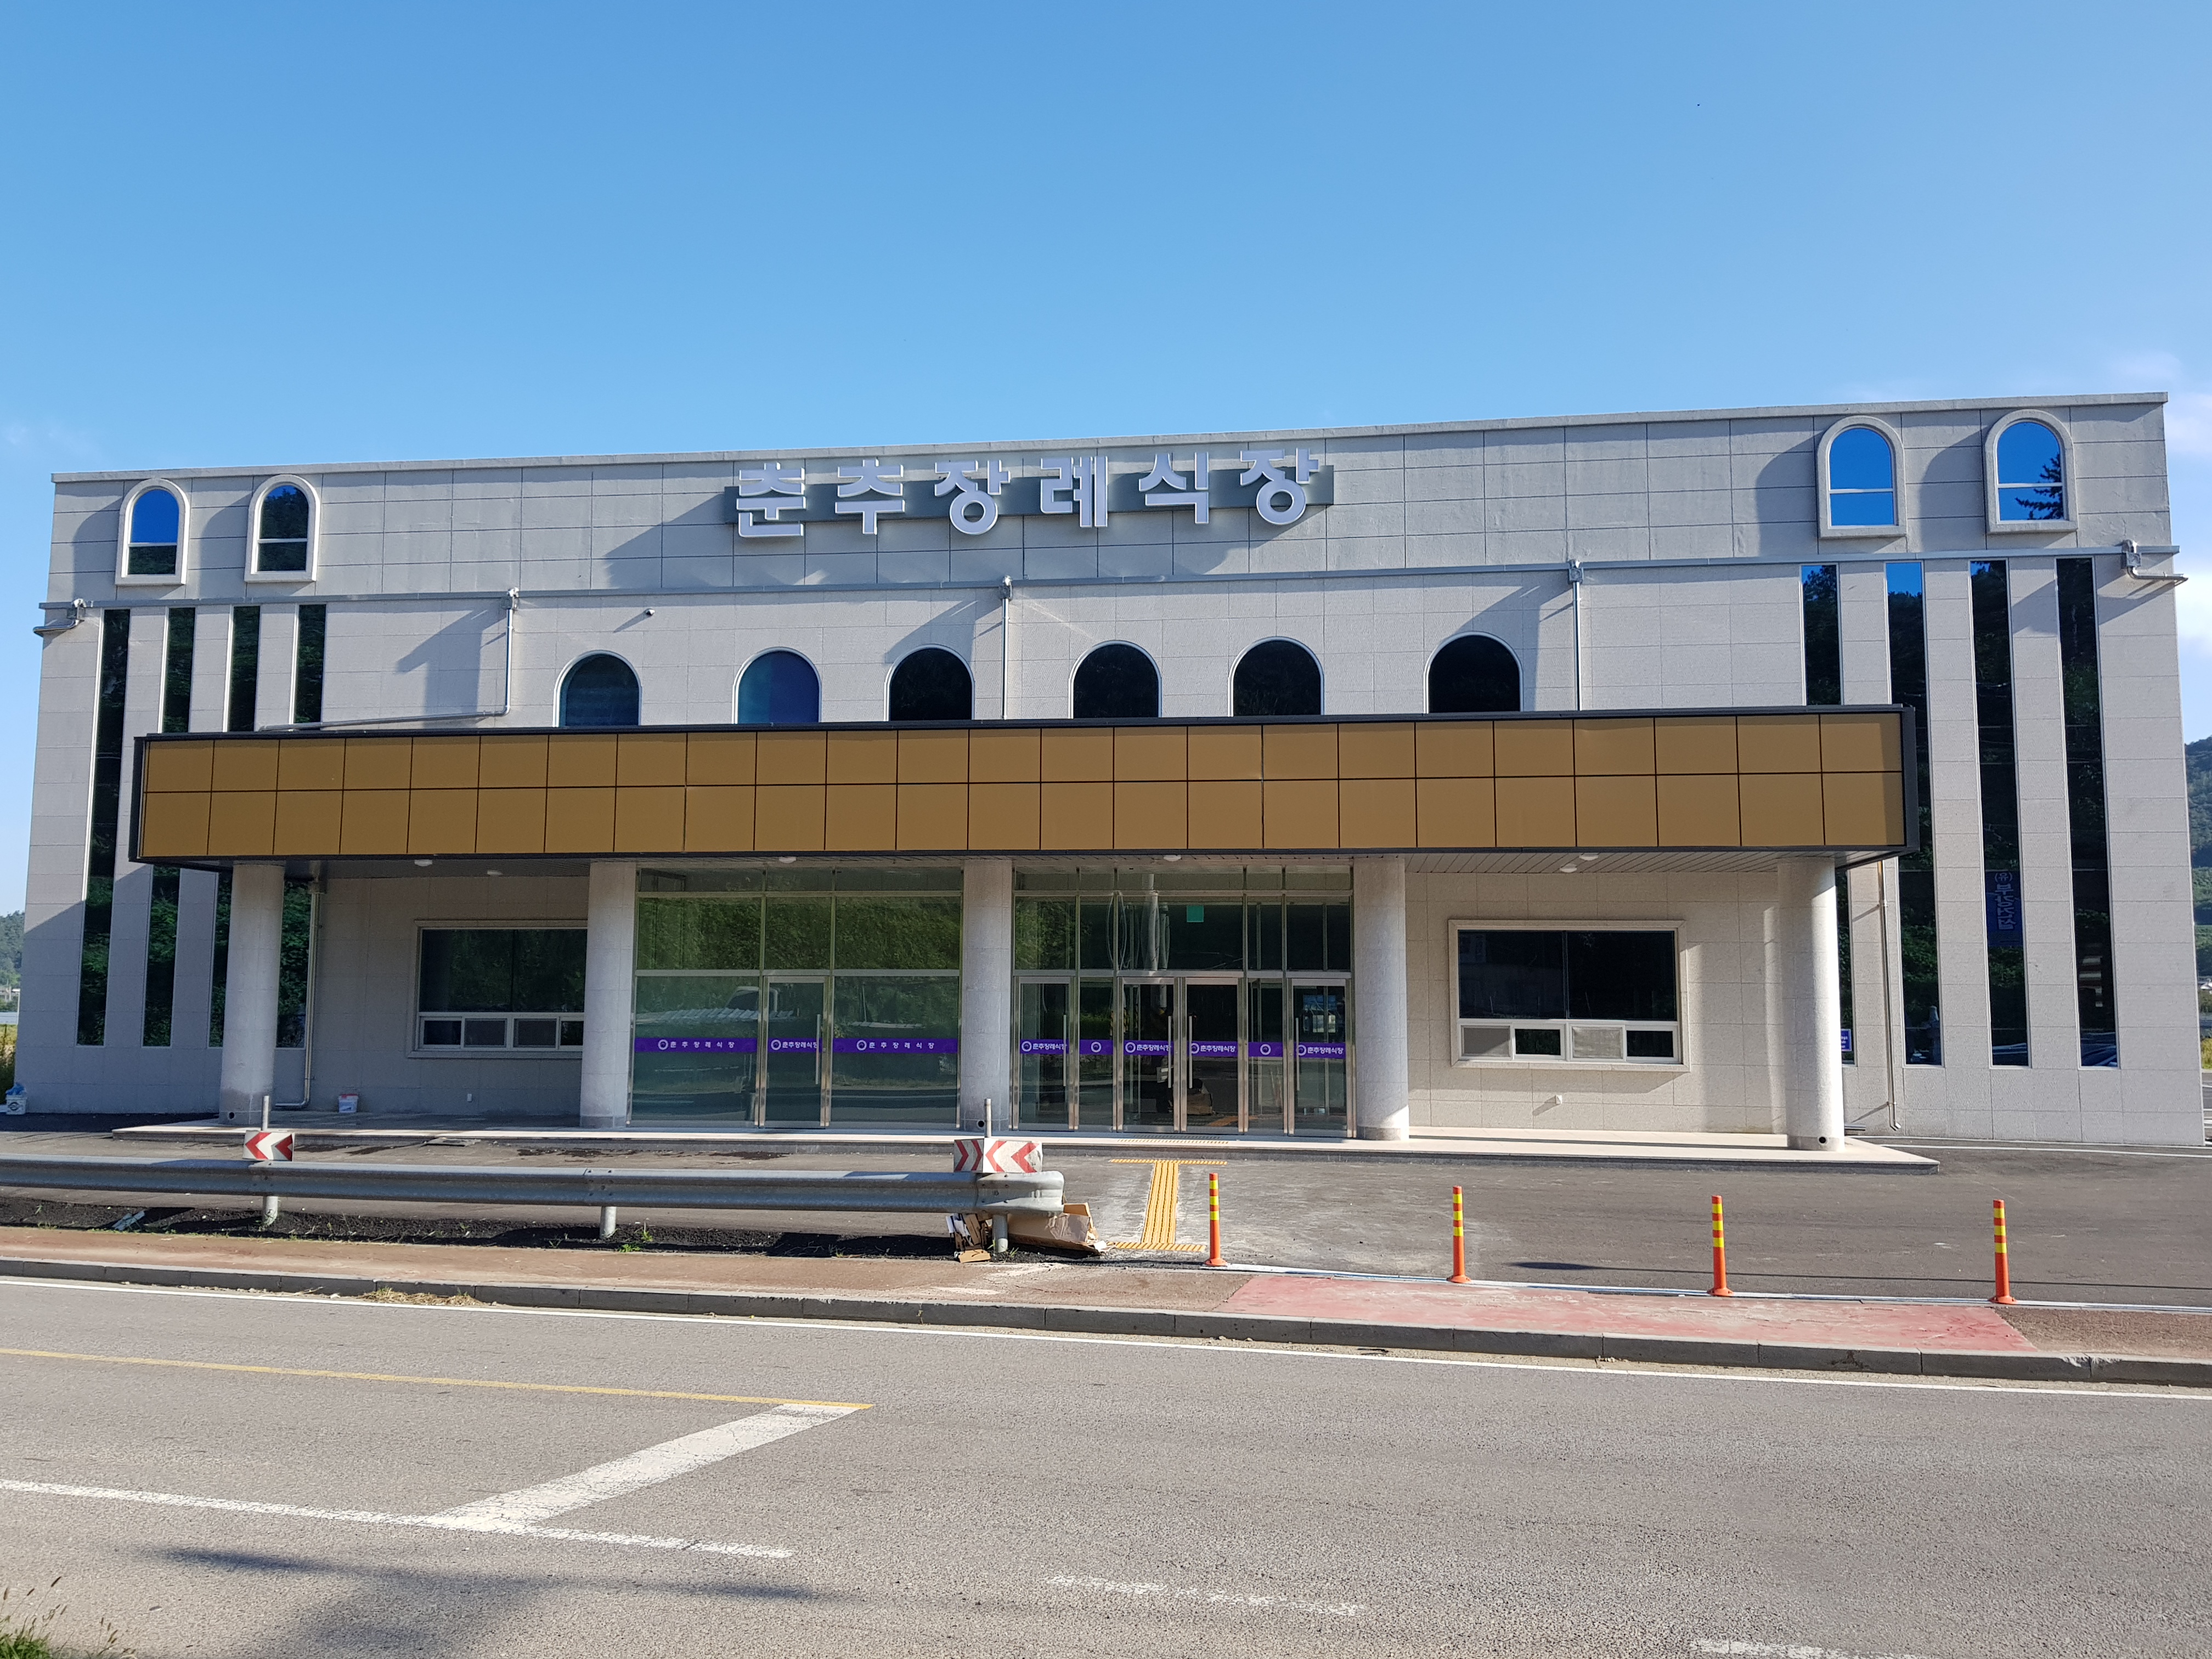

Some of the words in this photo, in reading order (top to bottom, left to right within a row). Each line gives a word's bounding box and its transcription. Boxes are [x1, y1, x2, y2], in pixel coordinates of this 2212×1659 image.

[736, 447, 1319, 538] 춘추장례식장
[868, 1041, 935, 1049] 춘추장례식장
[1200, 1045, 1236, 1053] 춘추장례식장
[1307, 1046, 1344, 1054] 춘추장례식장
